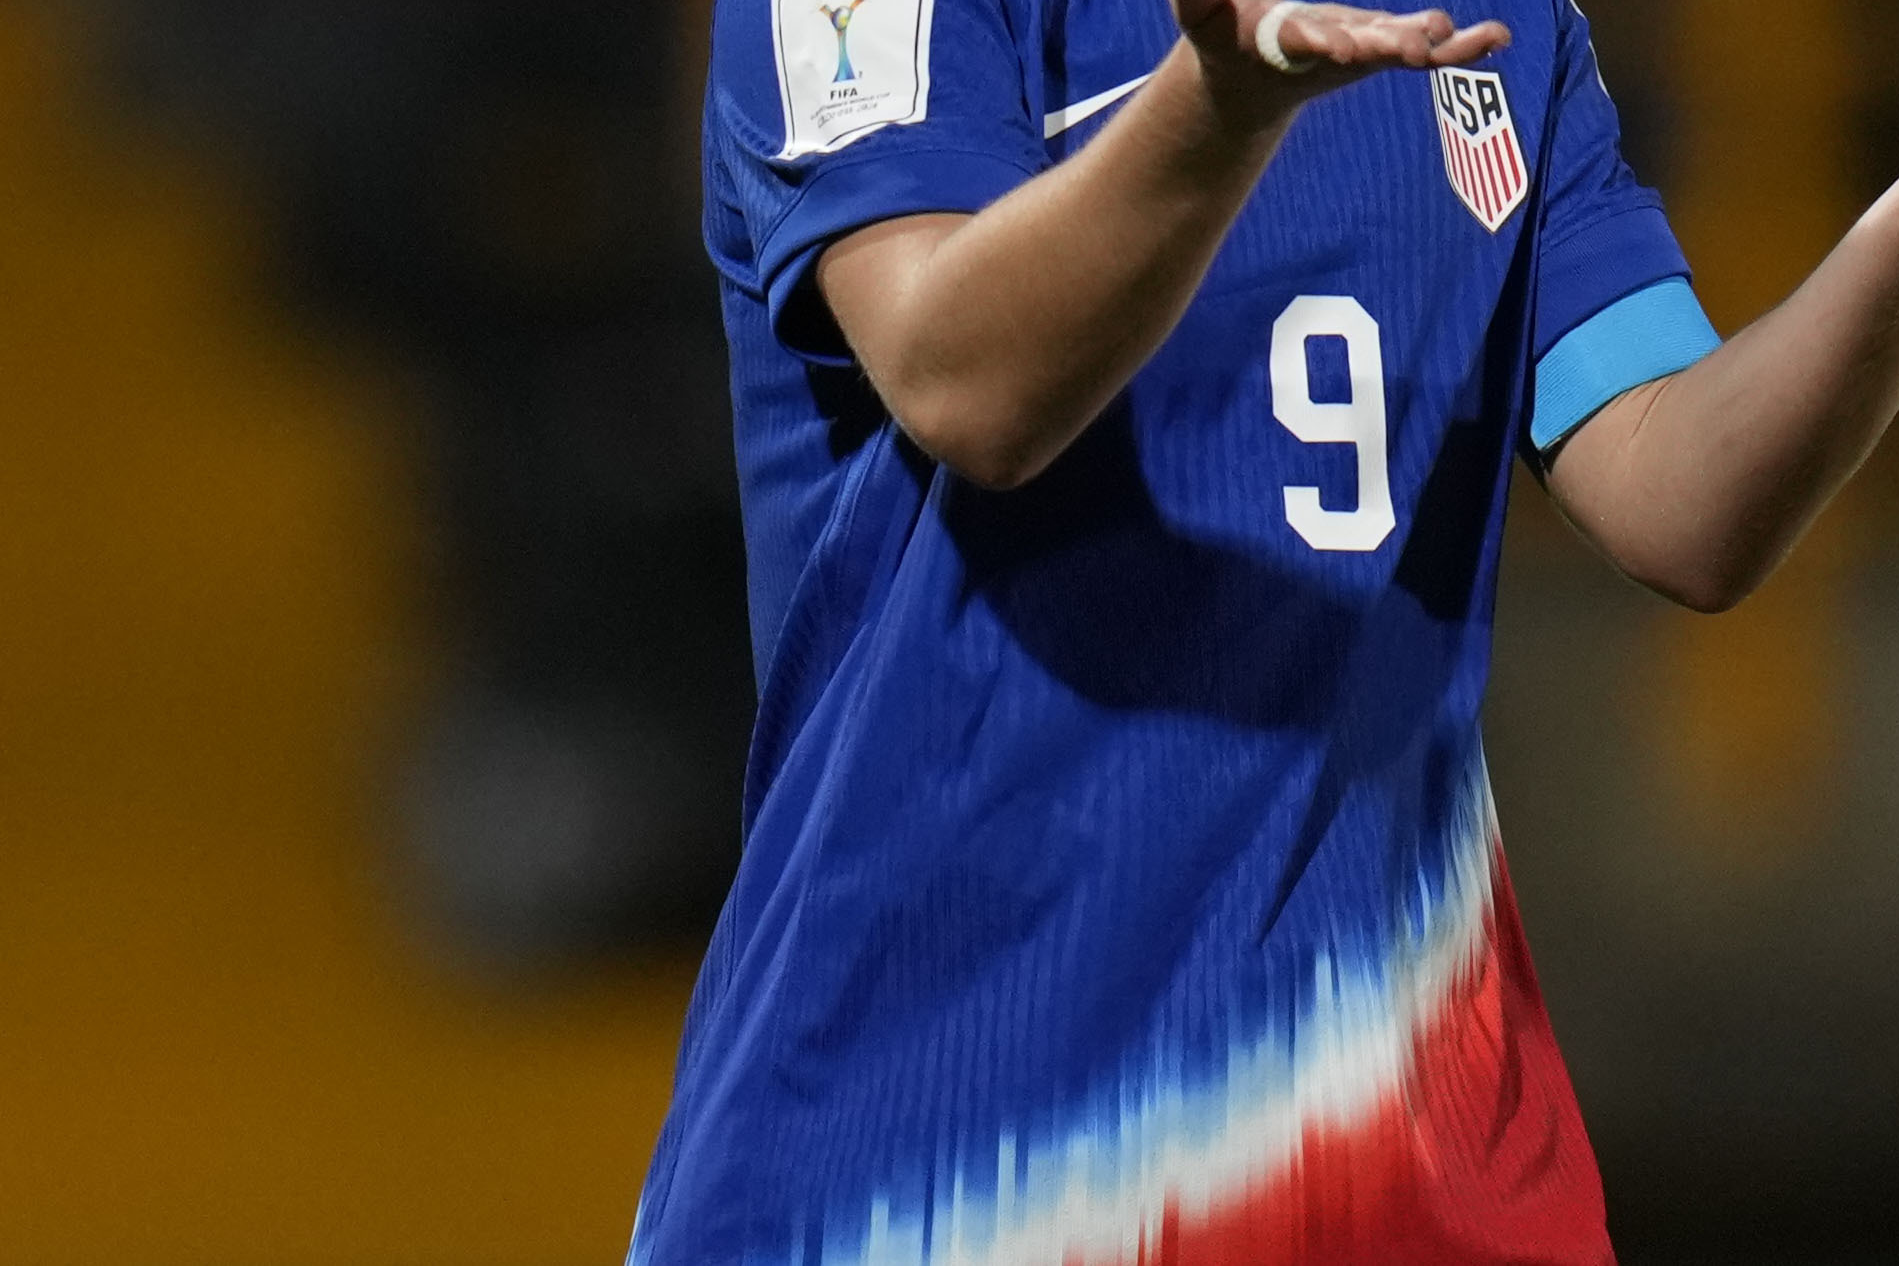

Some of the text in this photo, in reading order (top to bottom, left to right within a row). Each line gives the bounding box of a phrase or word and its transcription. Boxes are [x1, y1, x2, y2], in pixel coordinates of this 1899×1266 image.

[829, 87, 859, 100] FIFA
[1435, 67, 1503, 136] USA
[1269, 294, 1396, 552] 9
